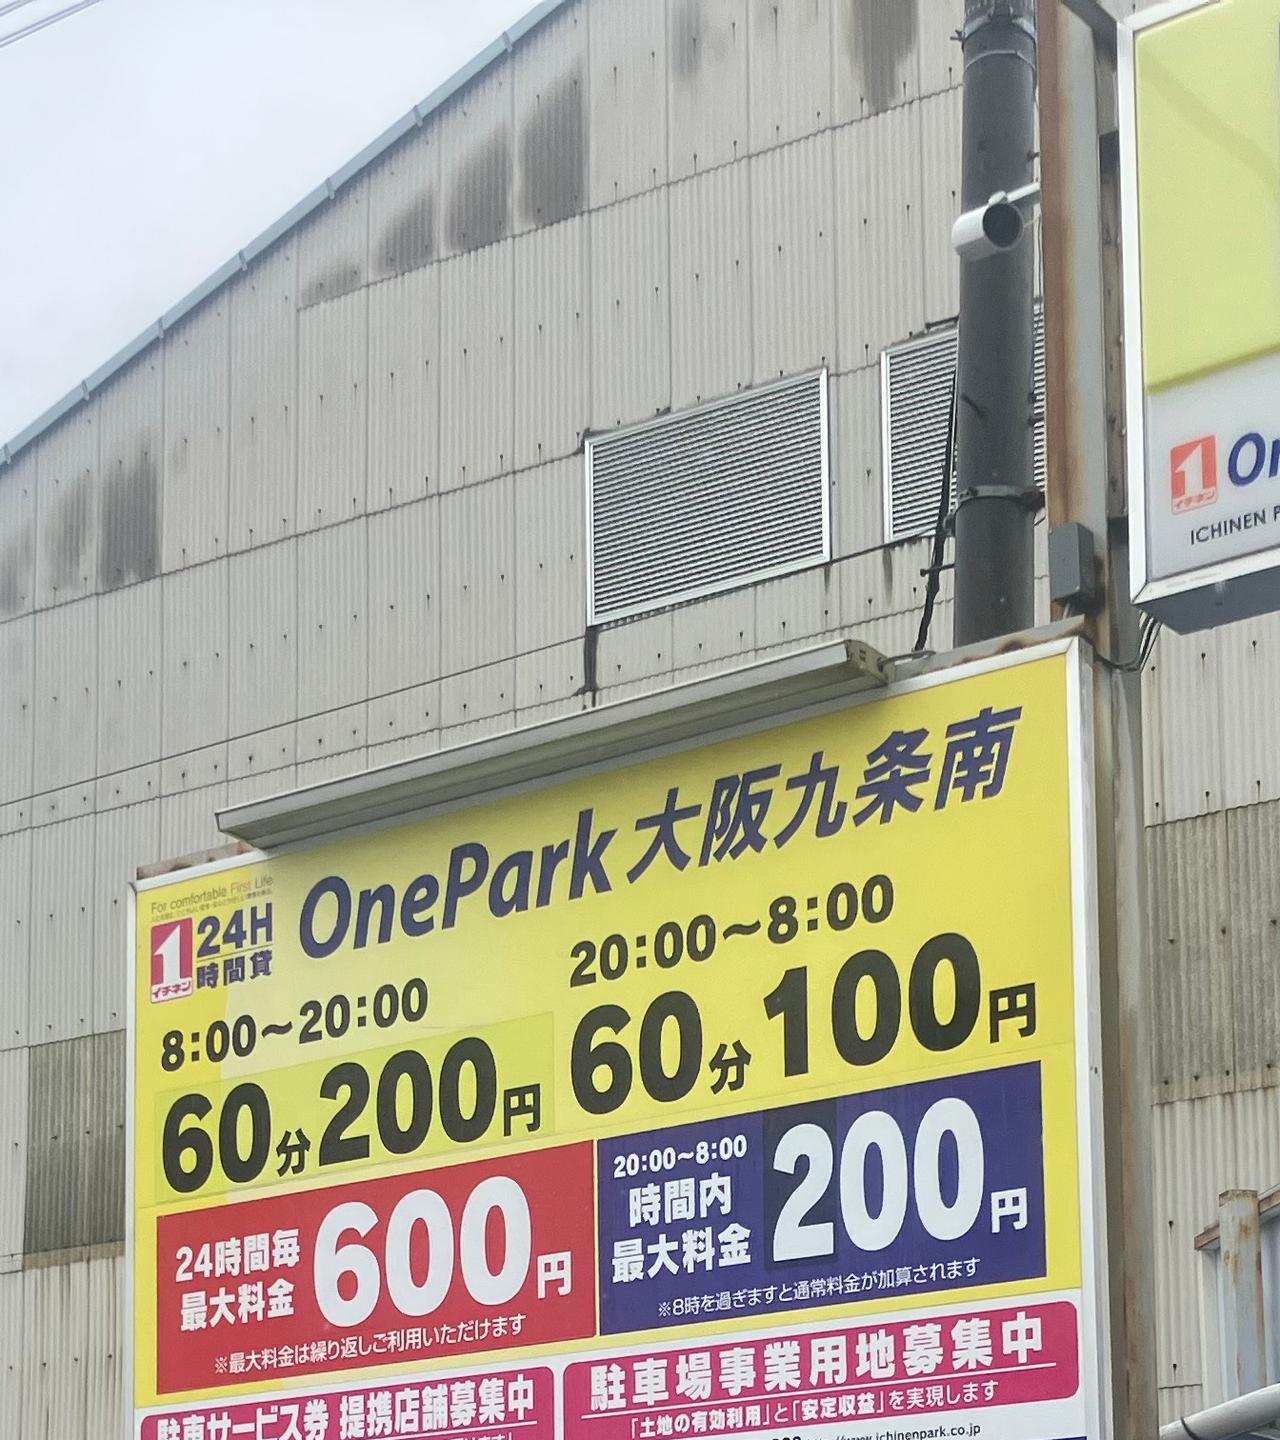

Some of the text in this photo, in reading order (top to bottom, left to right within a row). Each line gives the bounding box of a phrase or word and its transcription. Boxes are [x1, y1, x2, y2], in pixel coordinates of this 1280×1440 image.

[1190, 509, 1266, 545] ICHINEN
[299, 706, 1022, 959] OnePark 大阪九条南
[151, 902, 167, 914] For
[170, 887, 227, 910] comfortable
[231, 881, 251, 893] First
[197, 903, 273, 958] 24H
[152, 981, 191, 998] イチネン
[197, 950, 272, 989] 時間貸
[628, 1172, 732, 1228] 時間内
[772, 1097, 1028, 1262] 200円
[176, 1228, 301, 1282] 24時間毎
[314, 1176, 573, 1328] 600円
[611, 1223, 753, 1284] 最大料金
[180, 1278, 295, 1332] 最大料金
[590, 1311, 1044, 1412] 駐車場事業用地募集中
[339, 1373, 535, 1440] 提携店舗募集中
[630, 1379, 999, 1440] 「土地の有効利用」と「安定収益」を実現します
